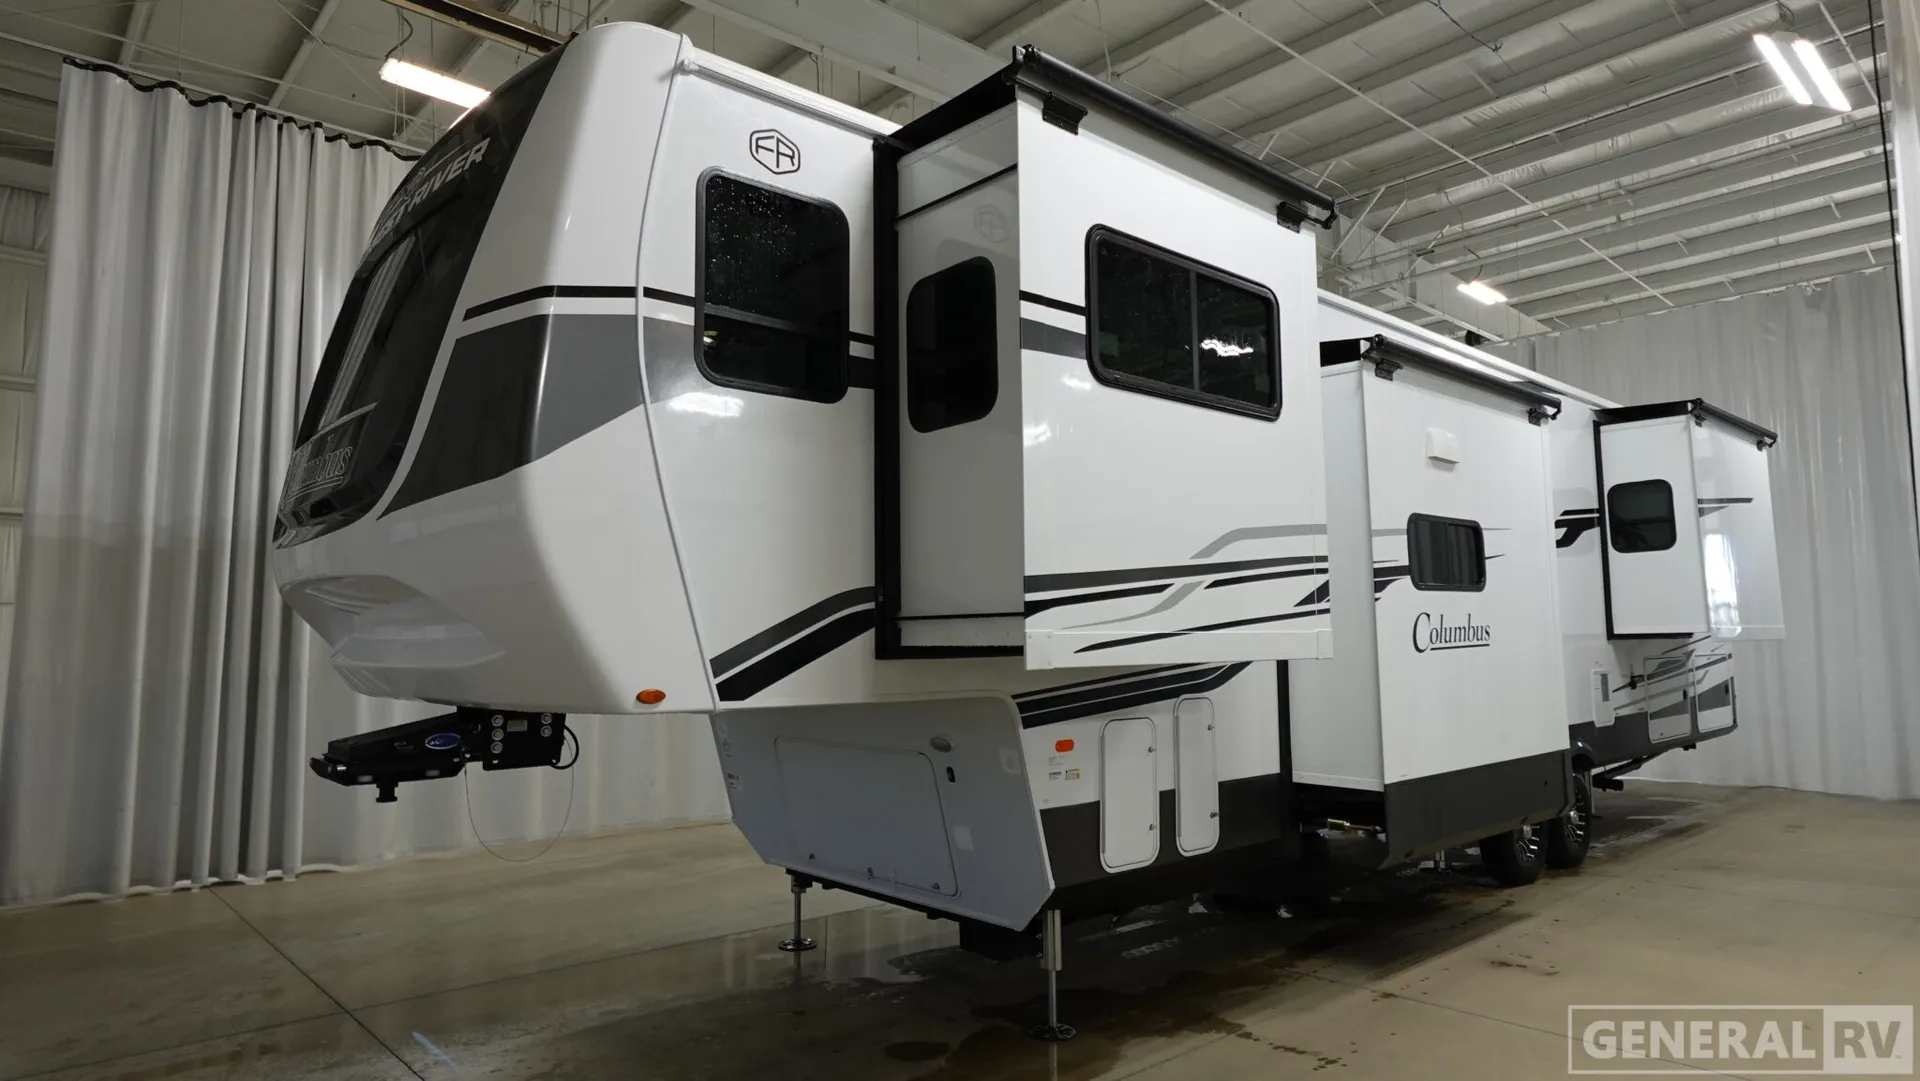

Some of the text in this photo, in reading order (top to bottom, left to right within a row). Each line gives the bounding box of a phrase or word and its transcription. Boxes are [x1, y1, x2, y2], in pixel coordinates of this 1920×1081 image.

[754, 135, 796, 169] FR
[408, 137, 490, 212] RIVER
[1412, 612, 1491, 653] Columbus
